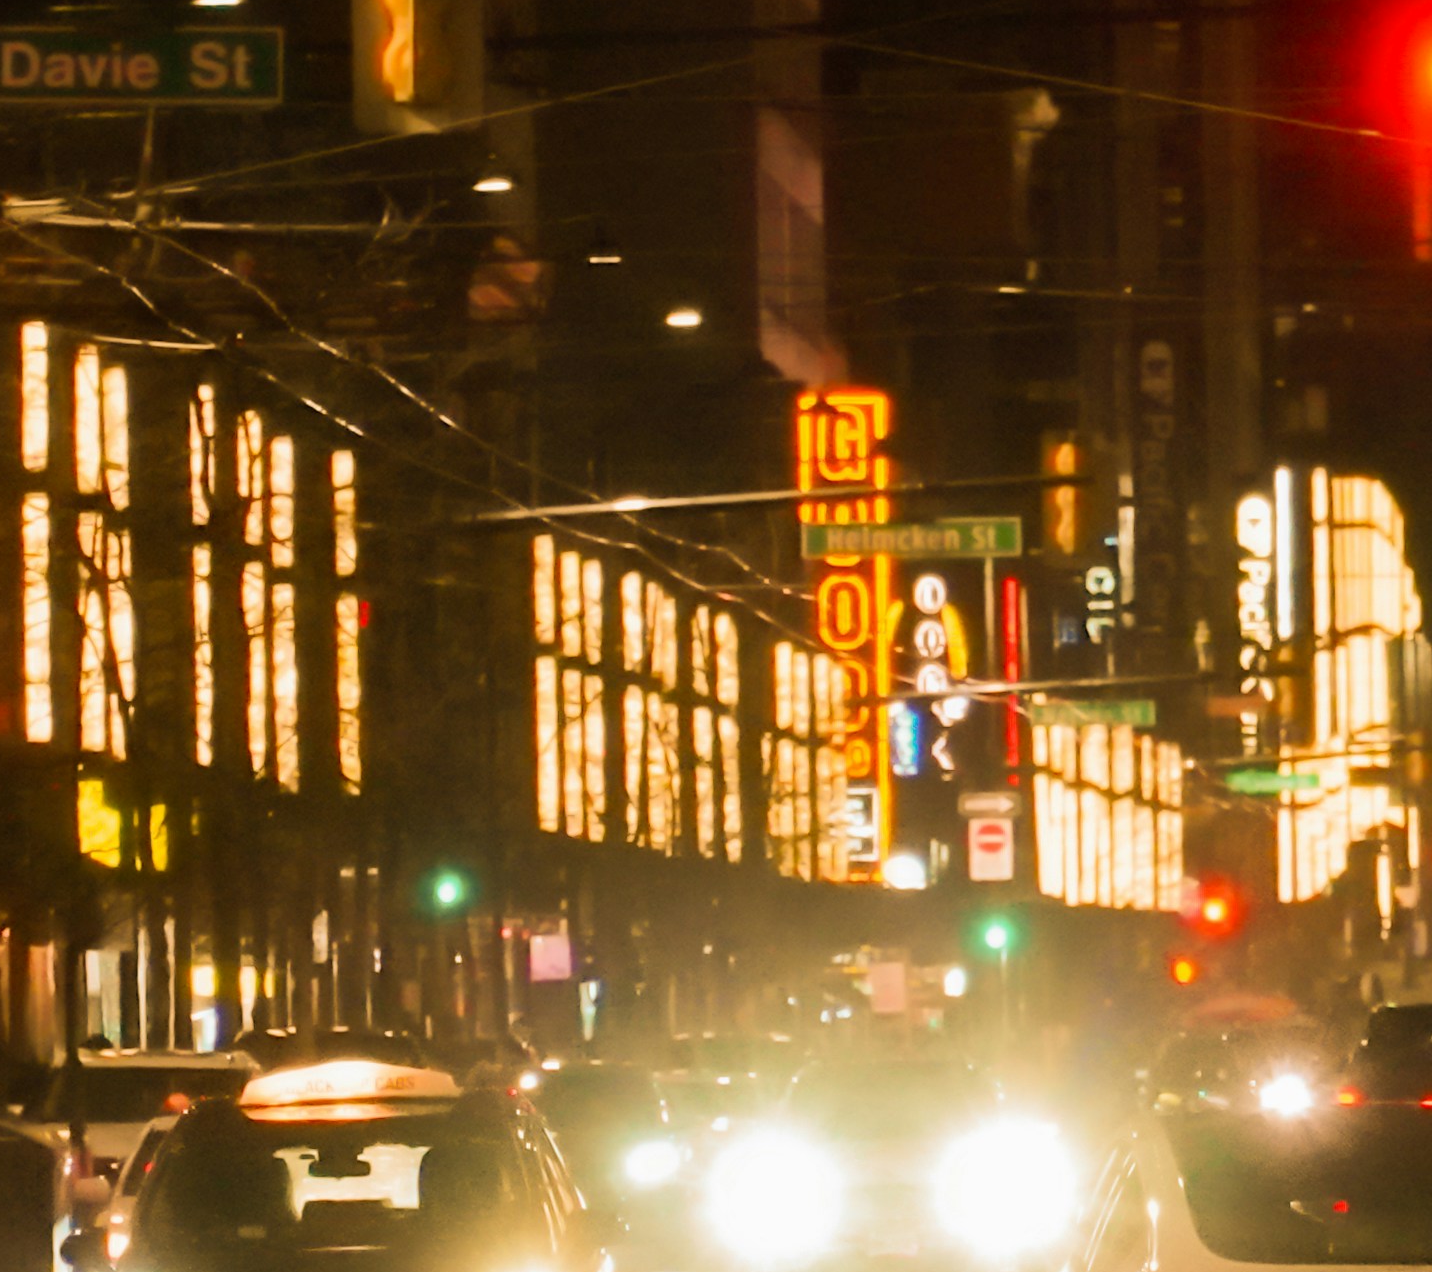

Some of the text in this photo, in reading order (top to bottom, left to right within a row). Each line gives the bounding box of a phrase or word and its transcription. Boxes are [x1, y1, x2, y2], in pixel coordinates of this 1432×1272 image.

[0, 41, 253, 90] Davie St
[825, 523, 997, 553] Helmcken St
